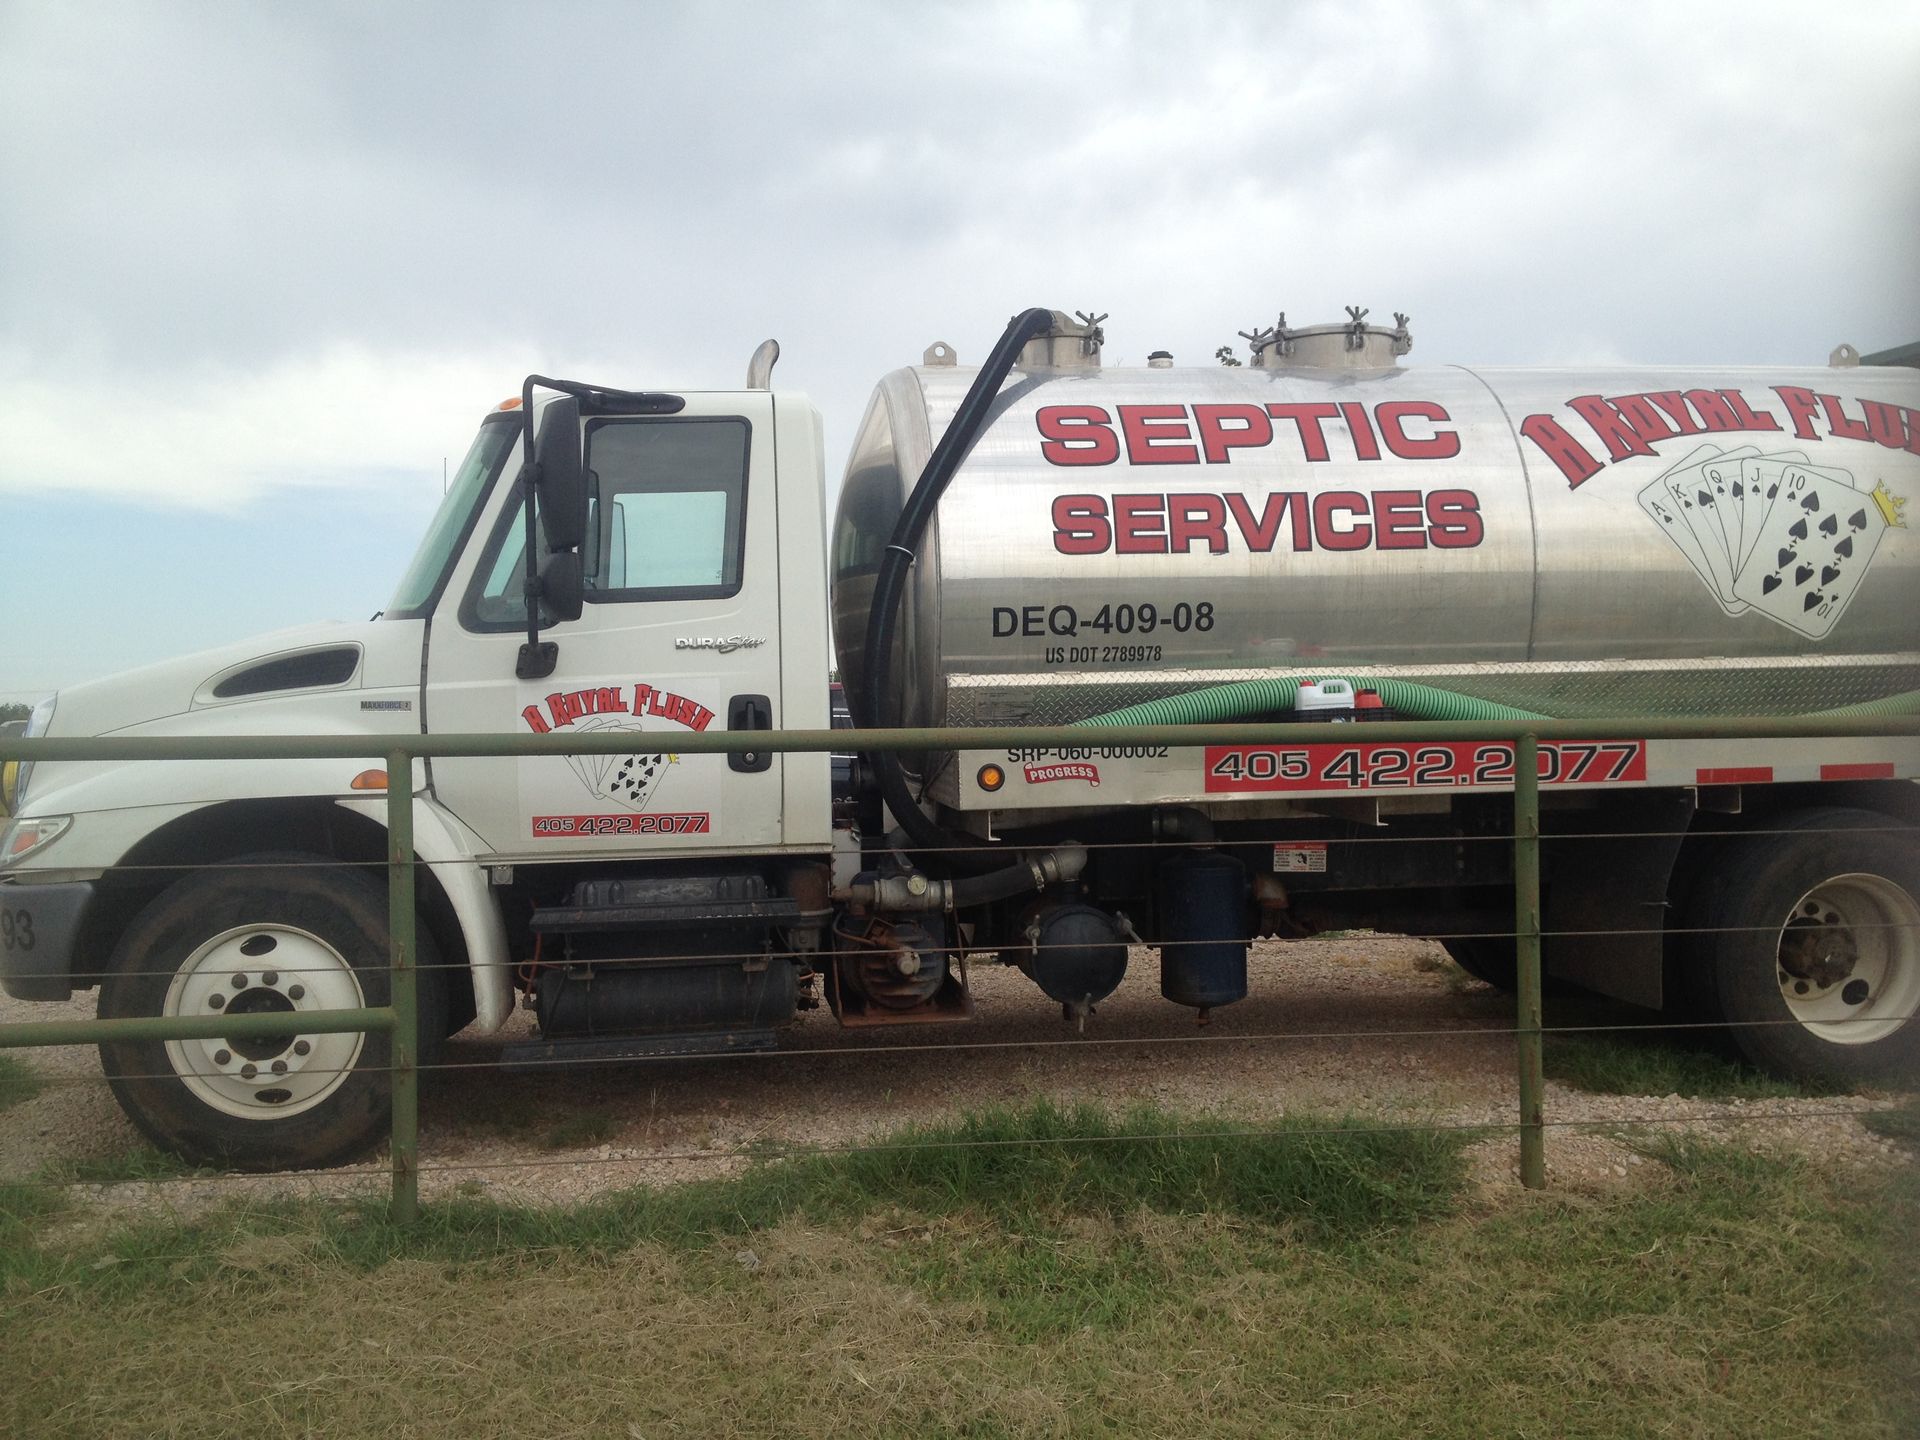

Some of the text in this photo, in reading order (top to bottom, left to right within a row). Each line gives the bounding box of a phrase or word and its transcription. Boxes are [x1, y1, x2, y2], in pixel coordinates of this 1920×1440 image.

[1035, 400, 1462, 467] SEPTIC
[1519, 413, 1607, 491] A
[1564, 388, 1784, 464] ROYAL
[1709, 469, 1723, 484] Q
[1750, 467, 1761, 482] J
[1788, 472, 1806, 491] 10
[1671, 483, 1687, 499] K
[1651, 501, 1666, 516] A
[1051, 488, 1485, 555] SERVICES
[992, 602, 1215, 638] DEQ-409-08
[1045, 645, 1162, 664] US DOT 2789978
[521, 683, 716, 733] A ROYAL FLUSH
[1029, 766, 1094, 782] PROGRESS
[1211, 741, 1640, 789] 405 422.2077
[535, 814, 707, 836] 405 422.2077
